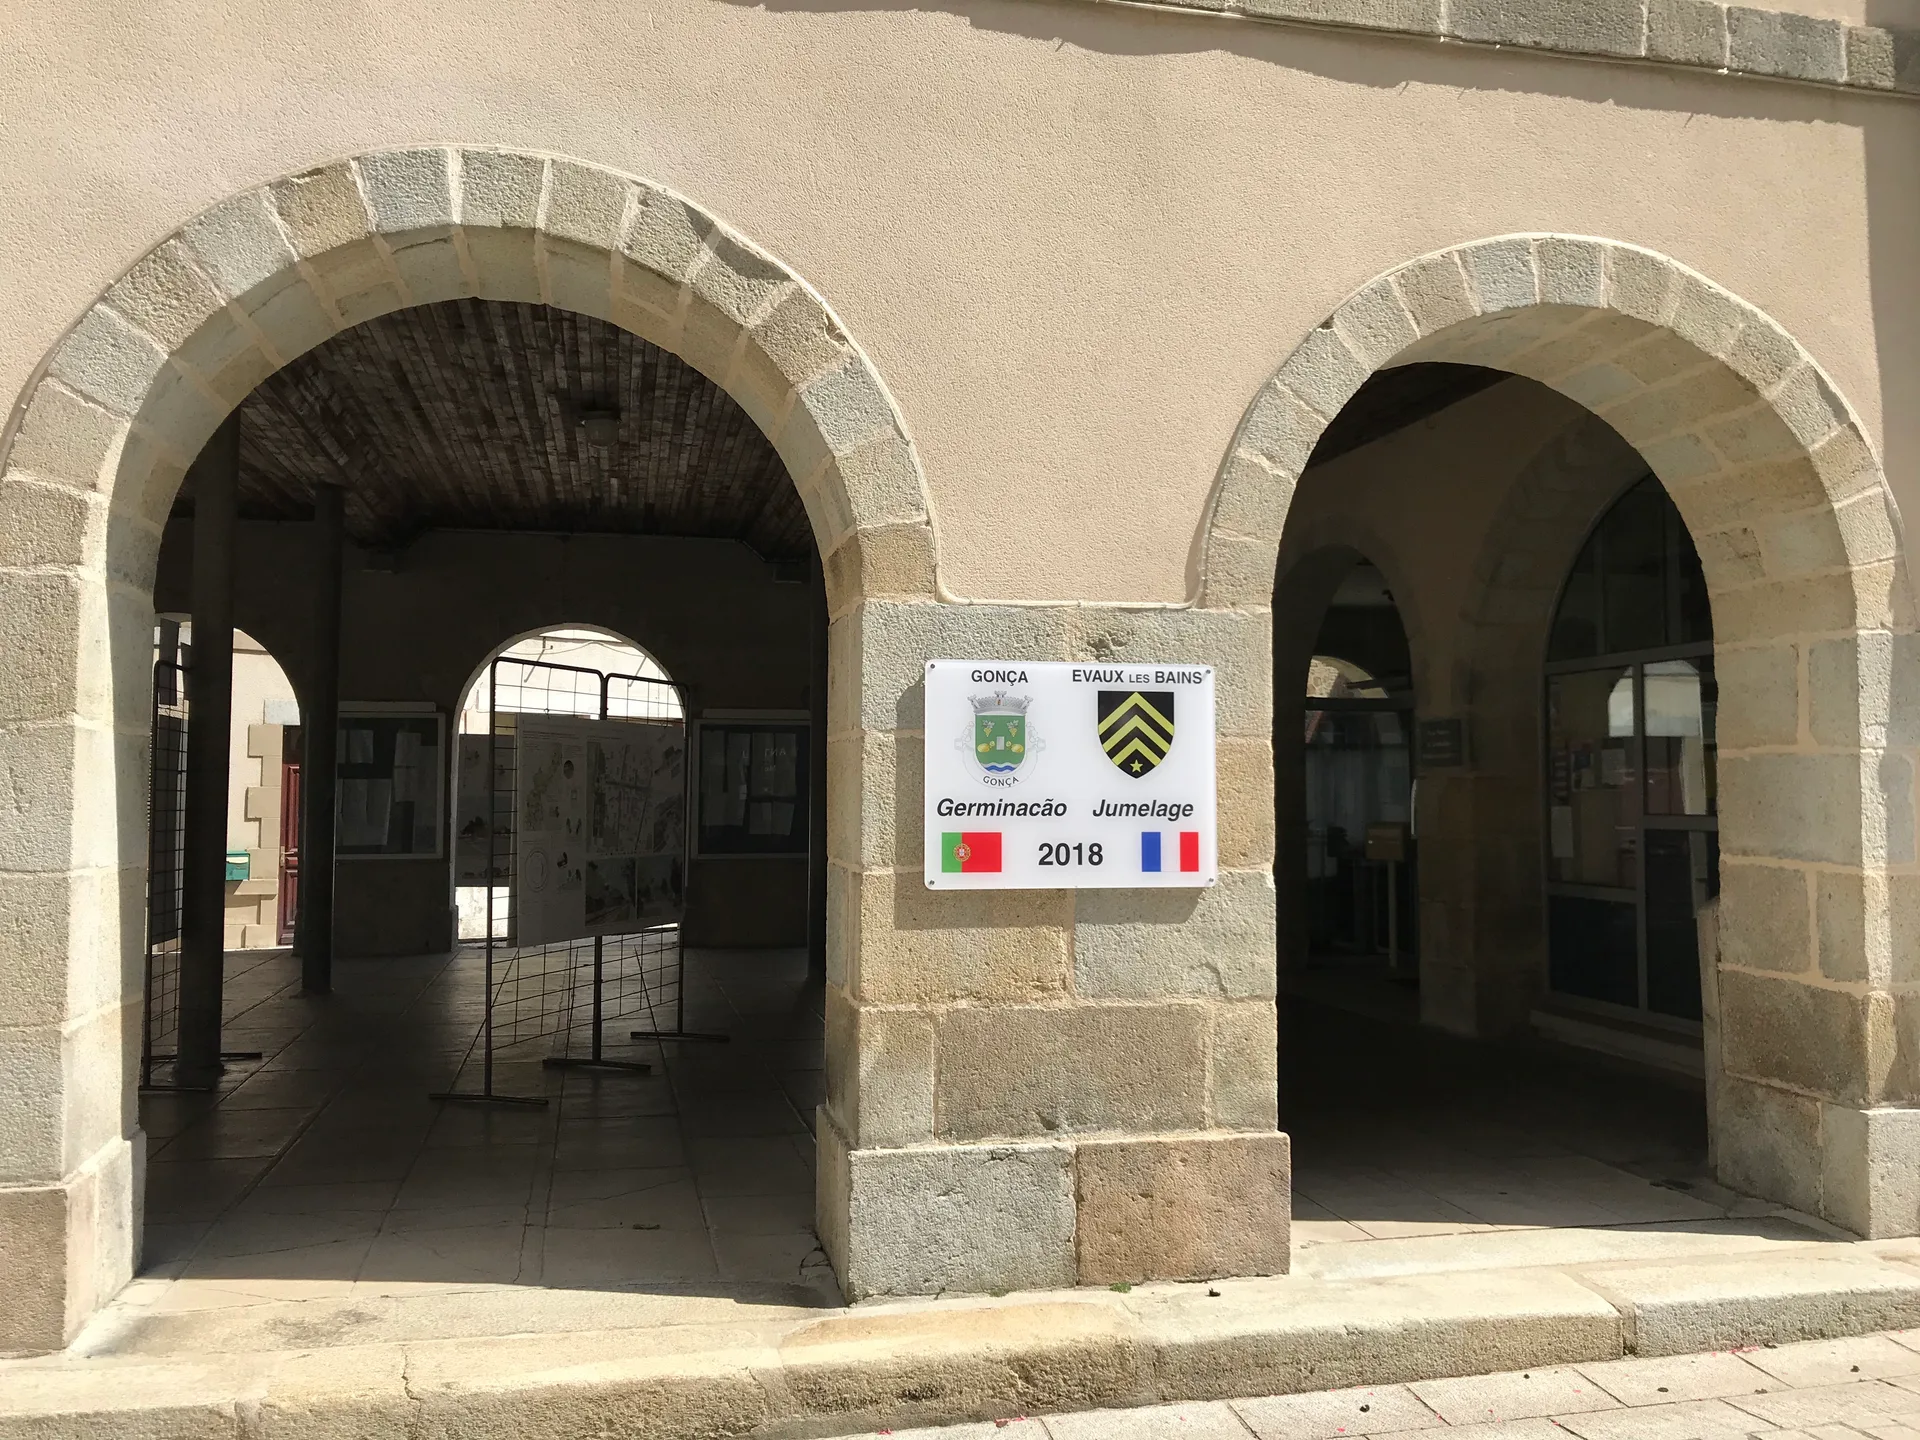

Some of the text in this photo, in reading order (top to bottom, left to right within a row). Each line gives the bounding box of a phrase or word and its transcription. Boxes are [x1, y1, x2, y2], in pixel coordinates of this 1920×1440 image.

[971, 669, 1029, 686] GONÇA
[1072, 669, 1203, 684] EVAUX LES BAINS
[982, 775, 1019, 788] GONÇA
[936, 798, 1068, 817] Germinacão
[1092, 799, 1194, 822] Jumelage
[1038, 842, 1104, 866] 2018
